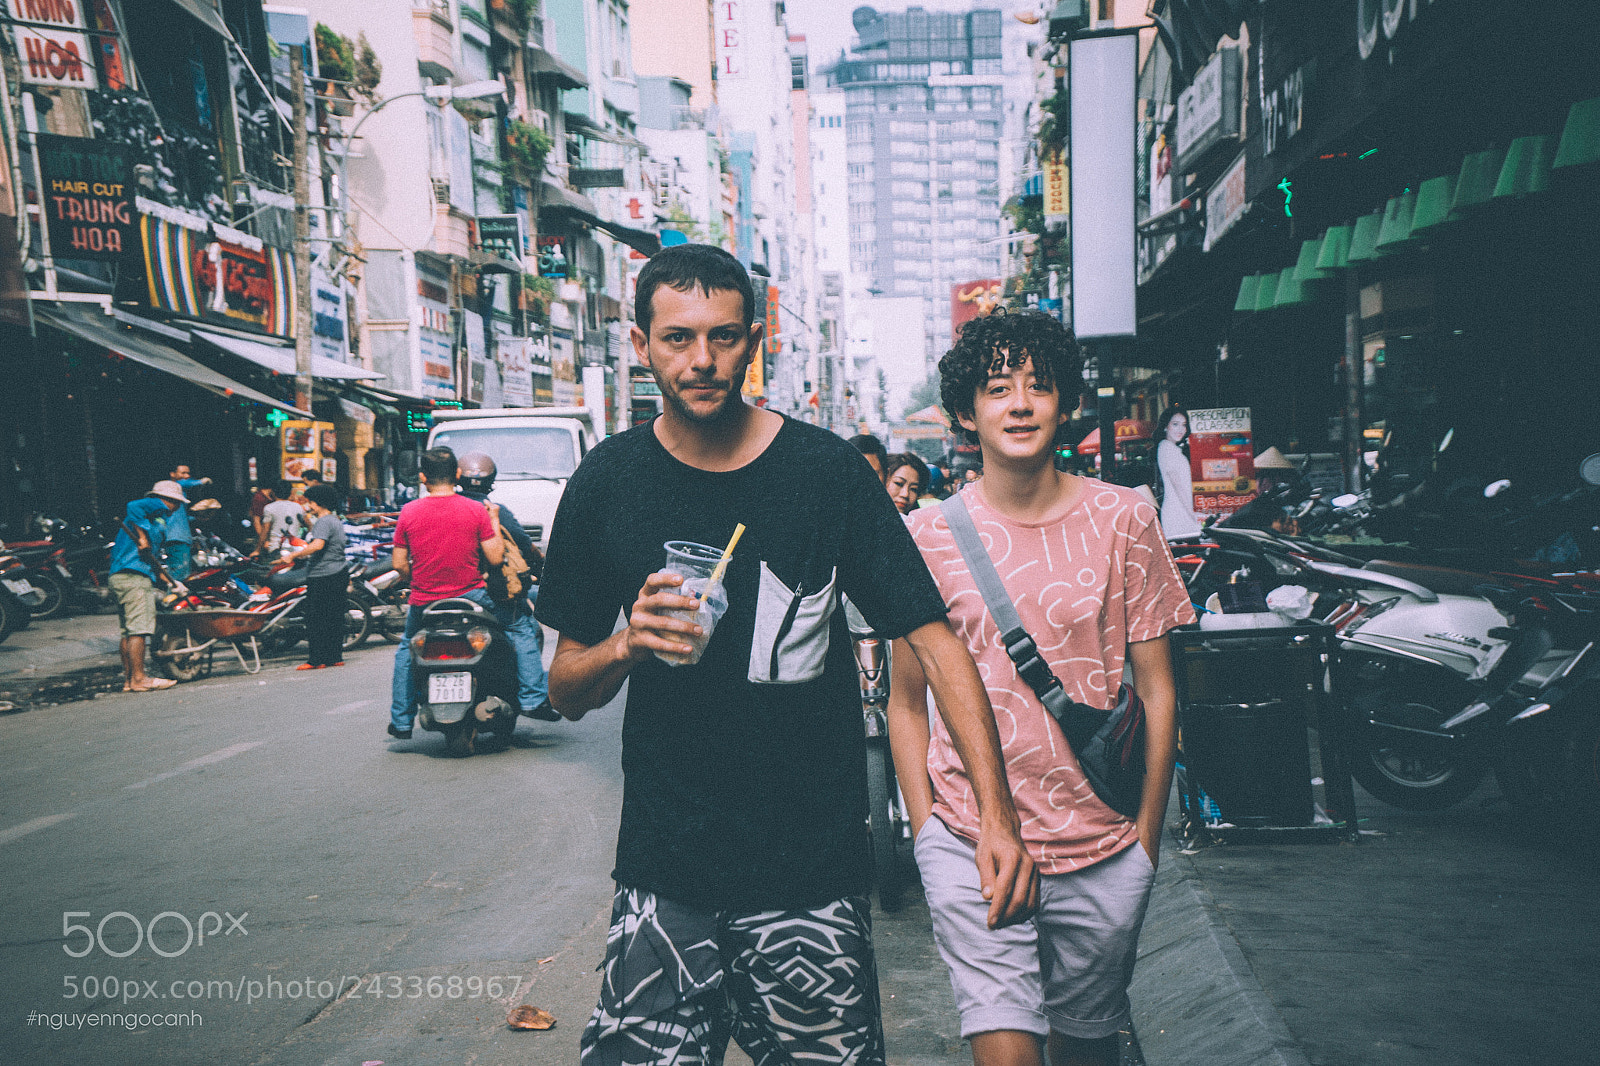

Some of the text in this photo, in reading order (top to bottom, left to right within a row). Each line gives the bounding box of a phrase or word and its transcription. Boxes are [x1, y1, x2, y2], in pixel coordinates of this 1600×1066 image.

[23, 36, 85, 82] HOA
[52, 180, 125, 197] HAIR CUT
[52, 195, 131, 225] TRUNG
[70, 226, 123, 252] HOA
[1195, 420, 1243, 432] GLASSES
[1194, 494, 1217, 509] Eye
[435, 688, 465, 701] 7010
